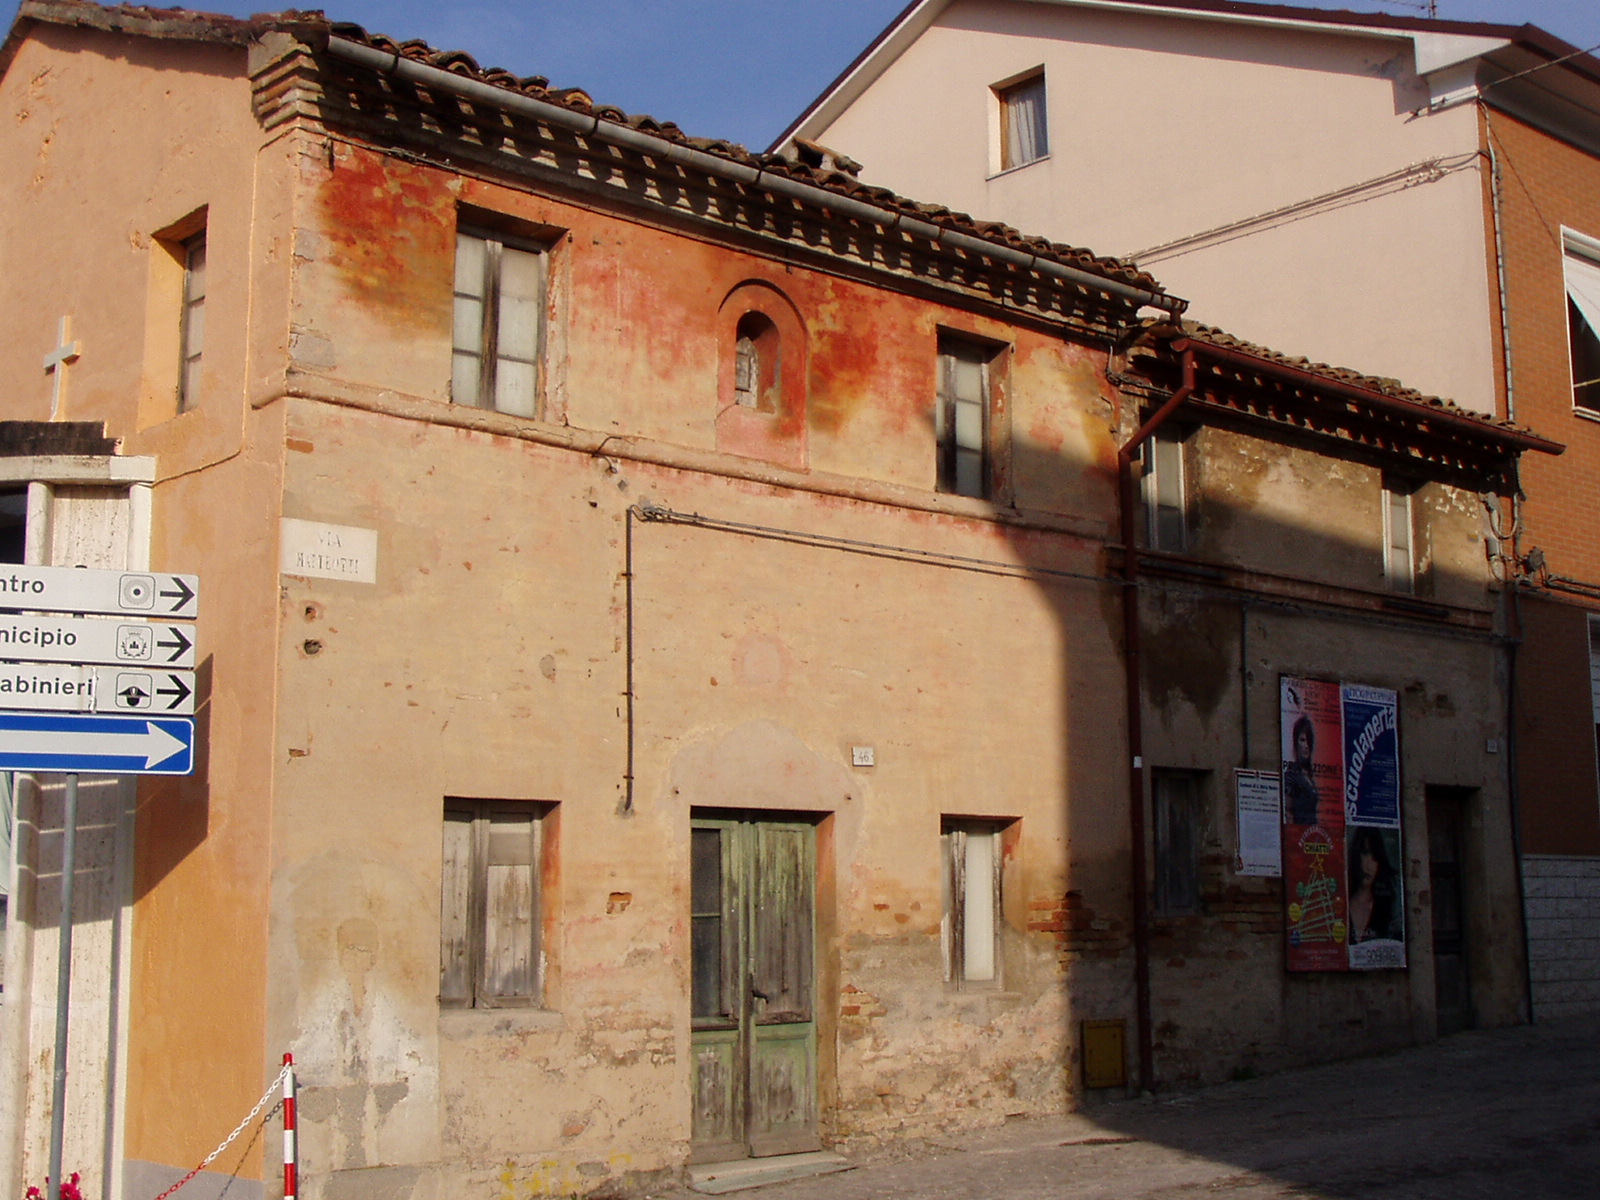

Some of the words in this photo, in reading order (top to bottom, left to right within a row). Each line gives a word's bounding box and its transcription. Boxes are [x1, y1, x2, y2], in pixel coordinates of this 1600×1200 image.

[317, 531, 341, 548] VIA
[0, 574, 45, 594] ntro
[0, 626, 77, 648] nicipio
[0, 675, 93, 696] abinieri
[858, 751, 870, 763] 46
[1345, 705, 1396, 818] scuolaperta
